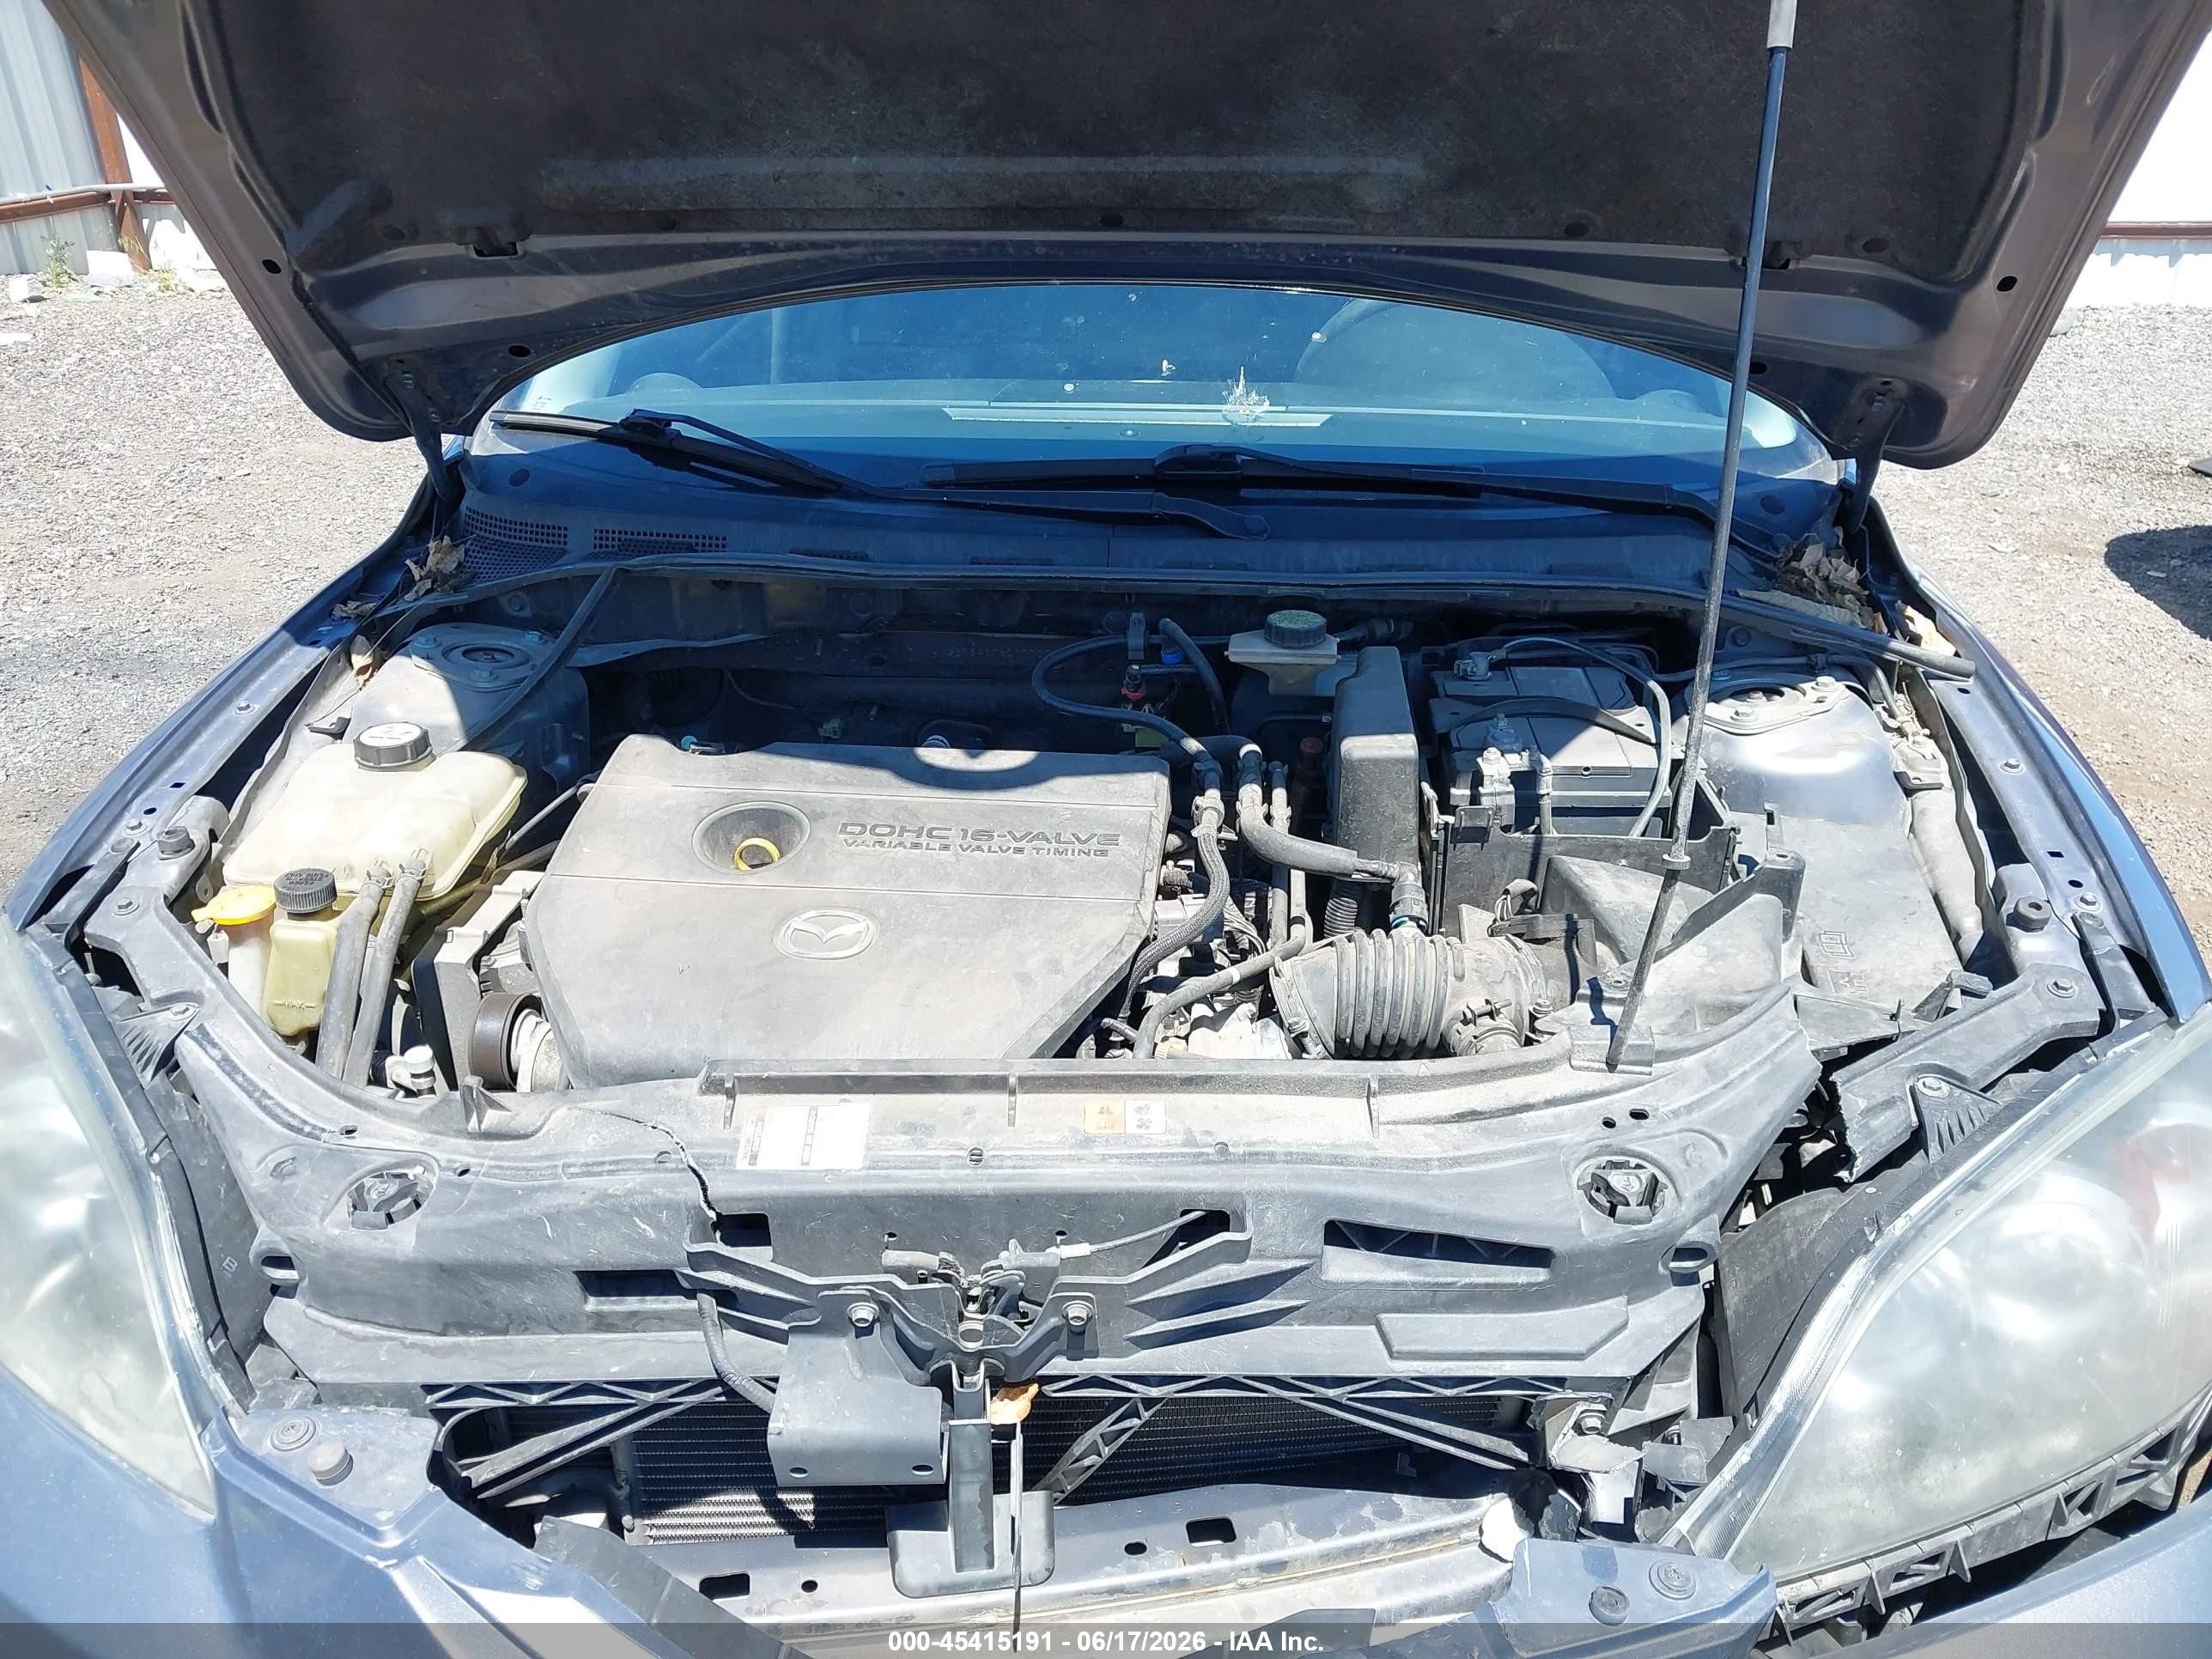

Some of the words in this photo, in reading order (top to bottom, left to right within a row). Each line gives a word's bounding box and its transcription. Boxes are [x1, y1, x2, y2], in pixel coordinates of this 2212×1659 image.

[838, 822, 953, 840] DOHC
[959, 827, 1121, 847] 16-VALVE
[843, 838, 951, 852] VARIABLE
[952, 843, 1025, 855] VALVE
[1032, 846, 1109, 858] TIMING
